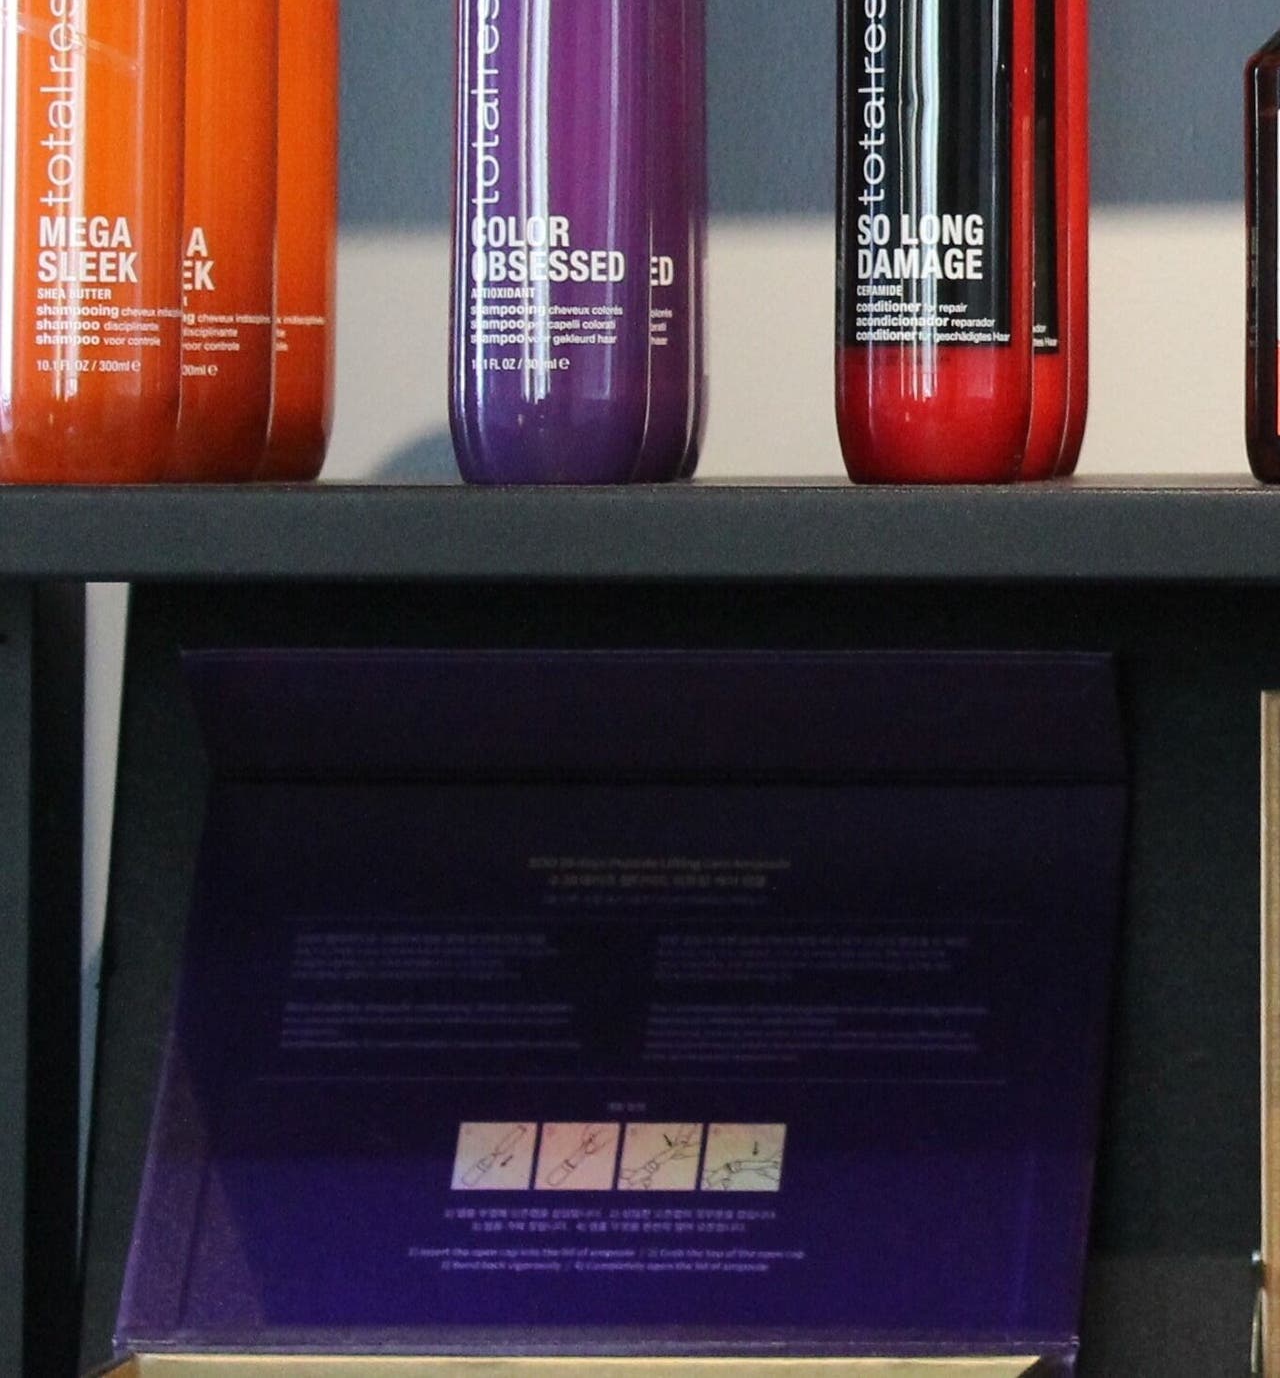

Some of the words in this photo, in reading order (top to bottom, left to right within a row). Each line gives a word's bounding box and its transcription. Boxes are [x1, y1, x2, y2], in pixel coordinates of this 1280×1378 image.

[39, 216, 132, 248] MEGA
[471, 216, 570, 247] COLOR
[857, 214, 891, 246] SO
[900, 214, 984, 246] LONG
[38, 251, 138, 283] SLEEK
[471, 250, 625, 282] OBSESSED
[857, 248, 983, 280] DAMAGE
[37, 288, 66, 299] SHEA
[70, 288, 112, 299] BUTTER
[471, 287, 535, 299] ATIOXIDANT
[856, 285, 903, 296] CERAMIDE
[36, 304, 119, 319] shampooing
[856, 300, 922, 313] conditioner
[939, 303, 968, 316] repair
[36, 318, 100, 331] shampoo
[471, 319, 524, 331] sampoo
[856, 314, 948, 327] acondicionador
[950, 317, 995, 330] reparador
[36, 333, 100, 346] shampoo
[471, 333, 524, 346] sampoo
[856, 328, 918, 341] conditioner
